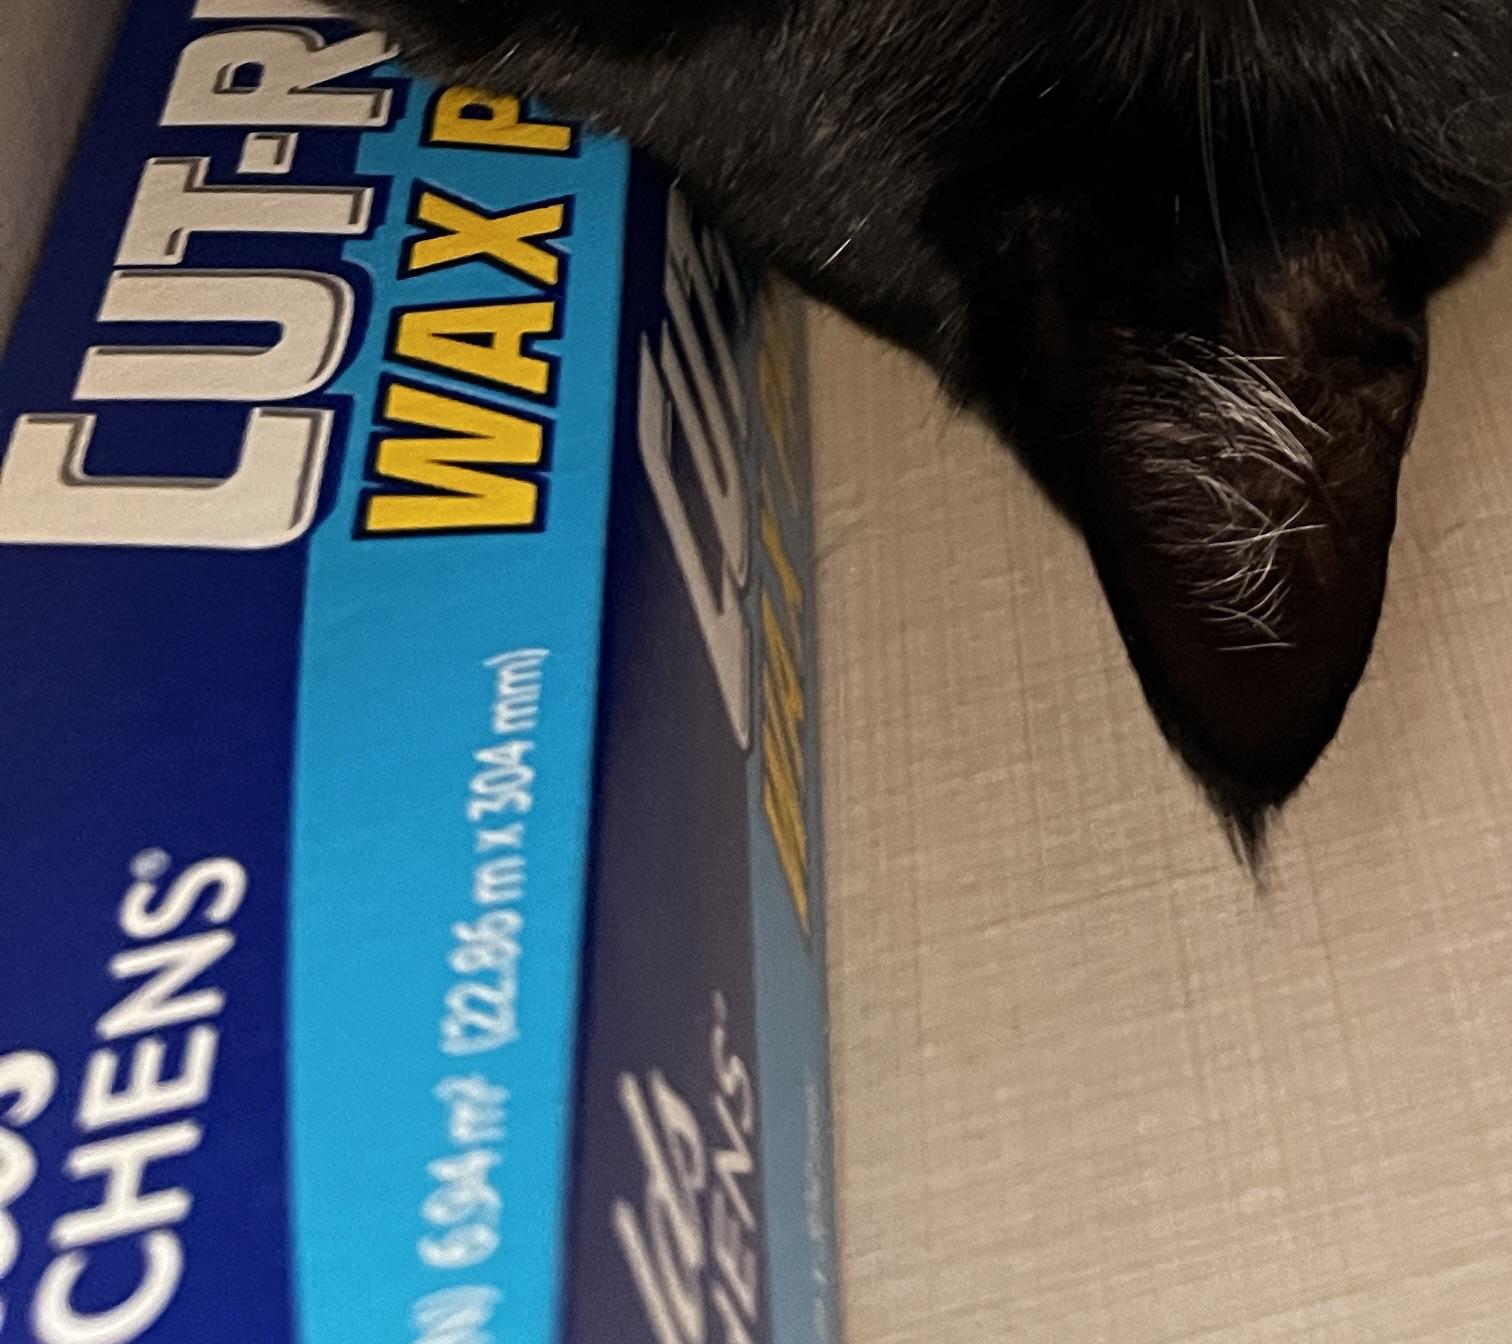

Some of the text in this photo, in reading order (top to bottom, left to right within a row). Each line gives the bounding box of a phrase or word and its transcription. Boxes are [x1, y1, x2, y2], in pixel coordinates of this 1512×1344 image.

[364, 192, 568, 532] WAX
[484, 648, 552, 735] mm)
[466, 739, 536, 823] 304
[474, 823, 523, 853] x
[472, 857, 527, 905] m
